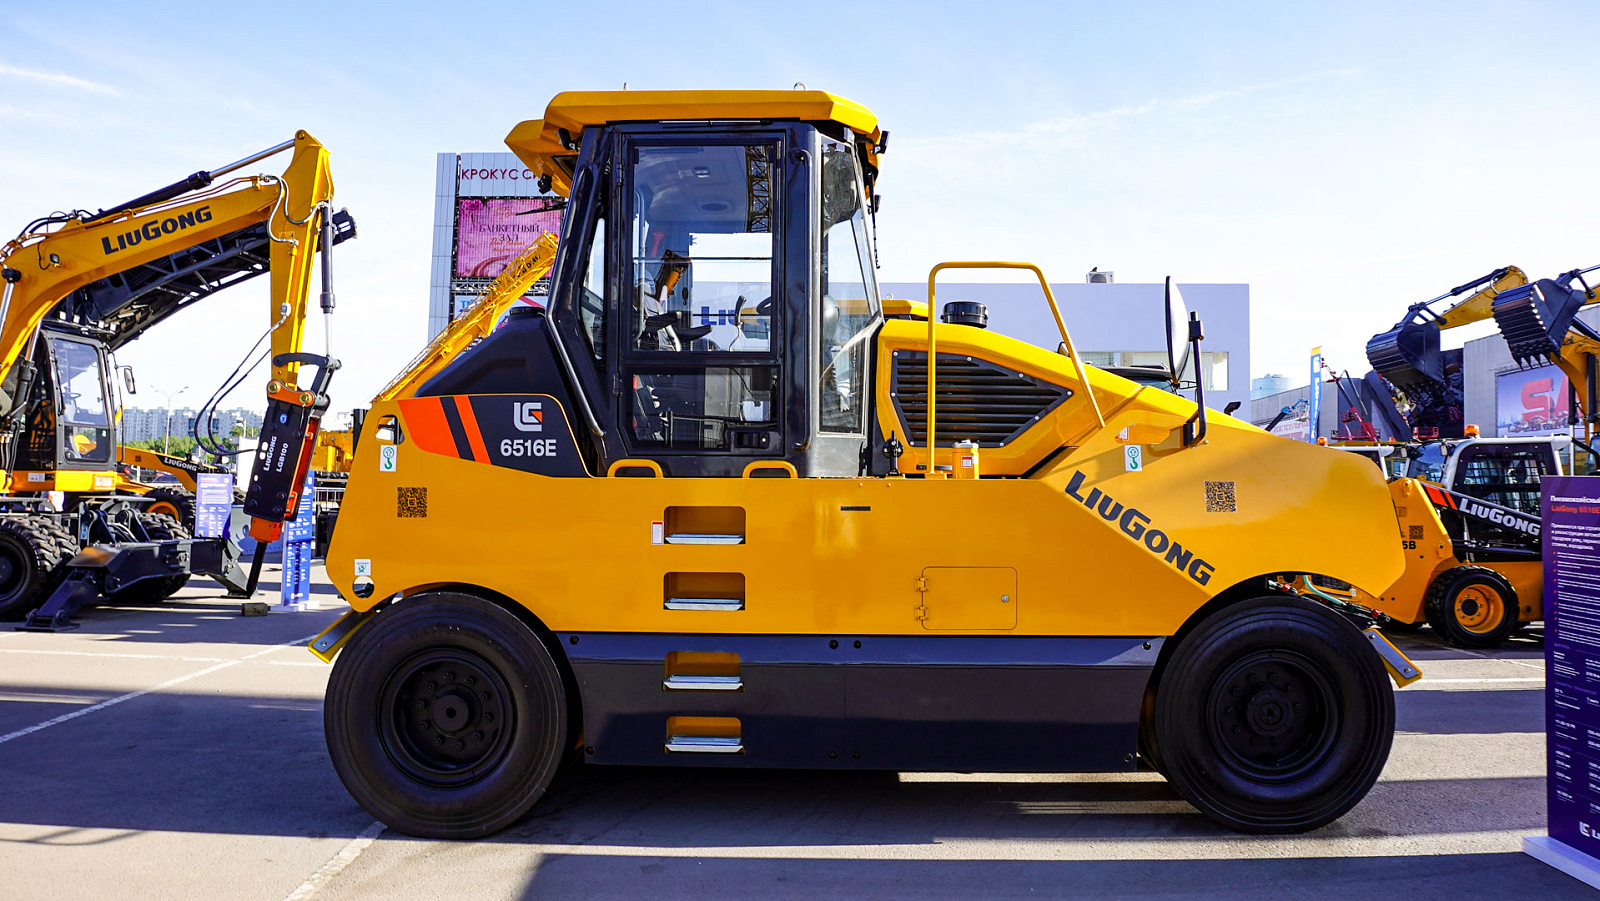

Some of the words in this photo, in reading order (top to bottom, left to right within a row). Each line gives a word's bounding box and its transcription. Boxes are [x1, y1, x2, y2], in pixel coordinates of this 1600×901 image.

[461, 169, 519, 180] КРОКУС
[101, 205, 213, 256] LIUGONG
[479, 223, 540, 233] БАНКЕТНЫЙ
[263, 435, 278, 472] LIUGONG
[276, 442, 289, 472] LGB100
[501, 439, 557, 457] 6516E
[164, 456, 197, 472] LIUGONG
[1064, 470, 1216, 587] LIUGONG
[1458, 498, 1542, 537] LIUGONG
